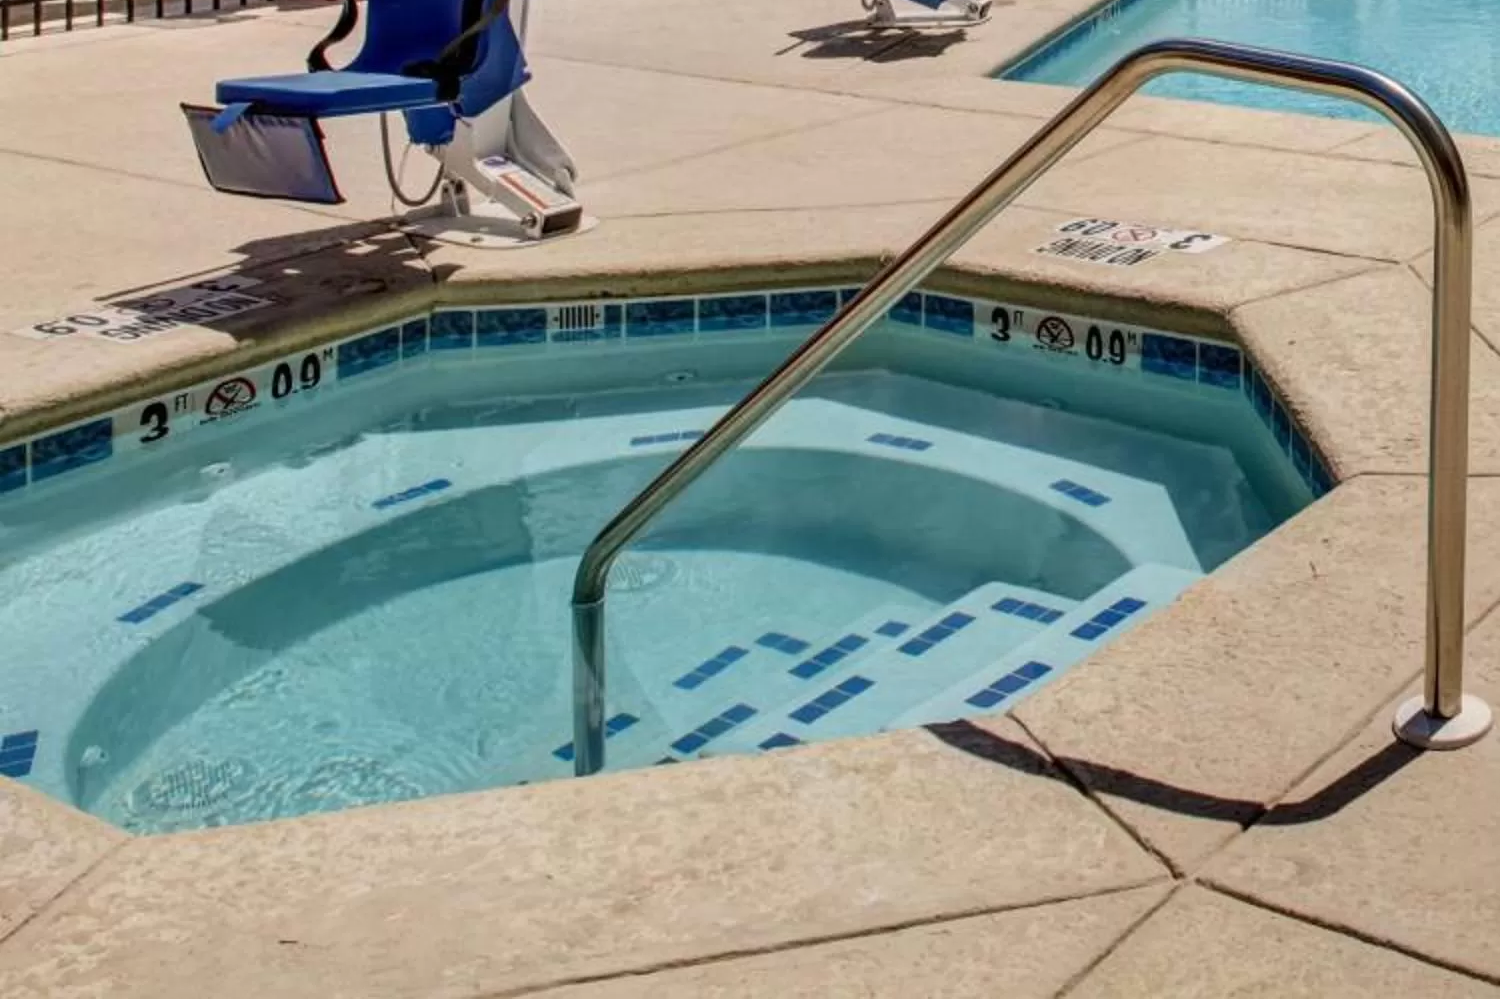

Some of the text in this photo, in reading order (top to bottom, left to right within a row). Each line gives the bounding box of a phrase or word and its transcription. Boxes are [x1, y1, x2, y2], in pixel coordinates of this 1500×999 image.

[991, 306, 1010, 342] 3
[1086, 324, 1126, 366] 0.9
[140, 401, 169, 444] 3
[271, 352, 321, 400] 0.9
